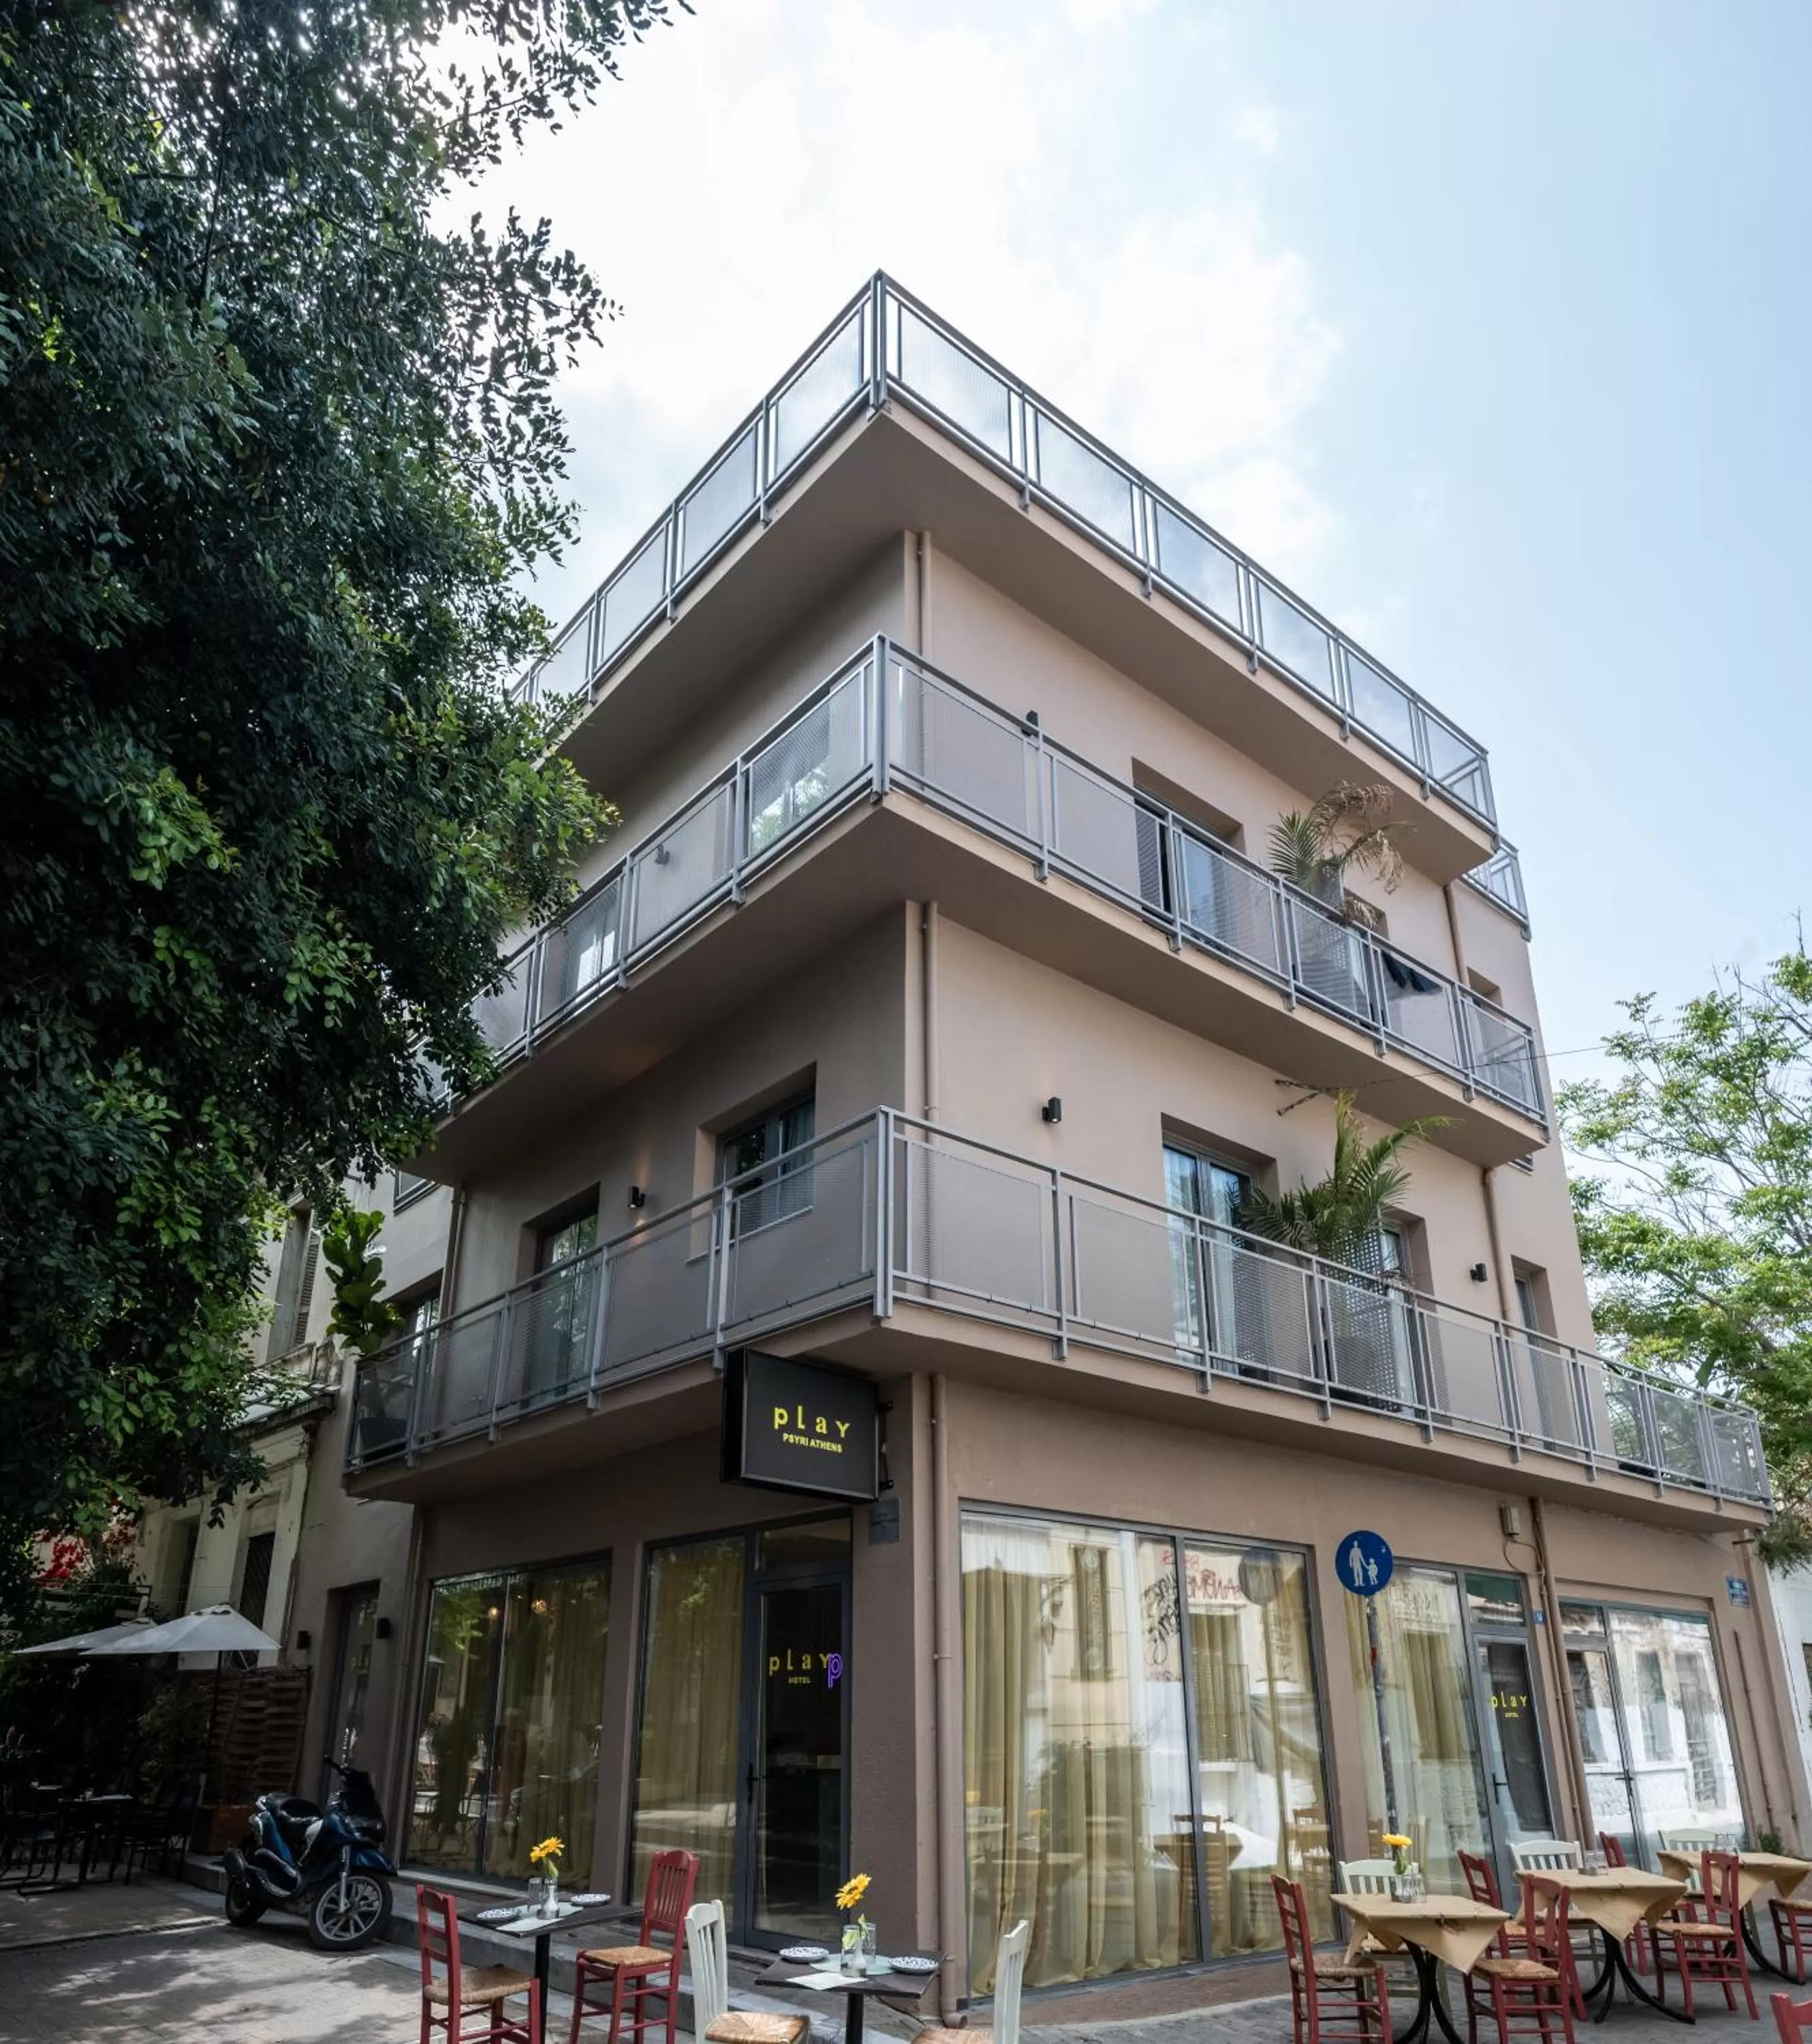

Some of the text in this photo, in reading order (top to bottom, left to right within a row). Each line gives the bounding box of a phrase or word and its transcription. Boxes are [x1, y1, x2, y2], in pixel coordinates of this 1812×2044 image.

[783, 1433, 843, 1453] PSYRI ATHENS
[788, 1676, 811, 1684] HOTEL
